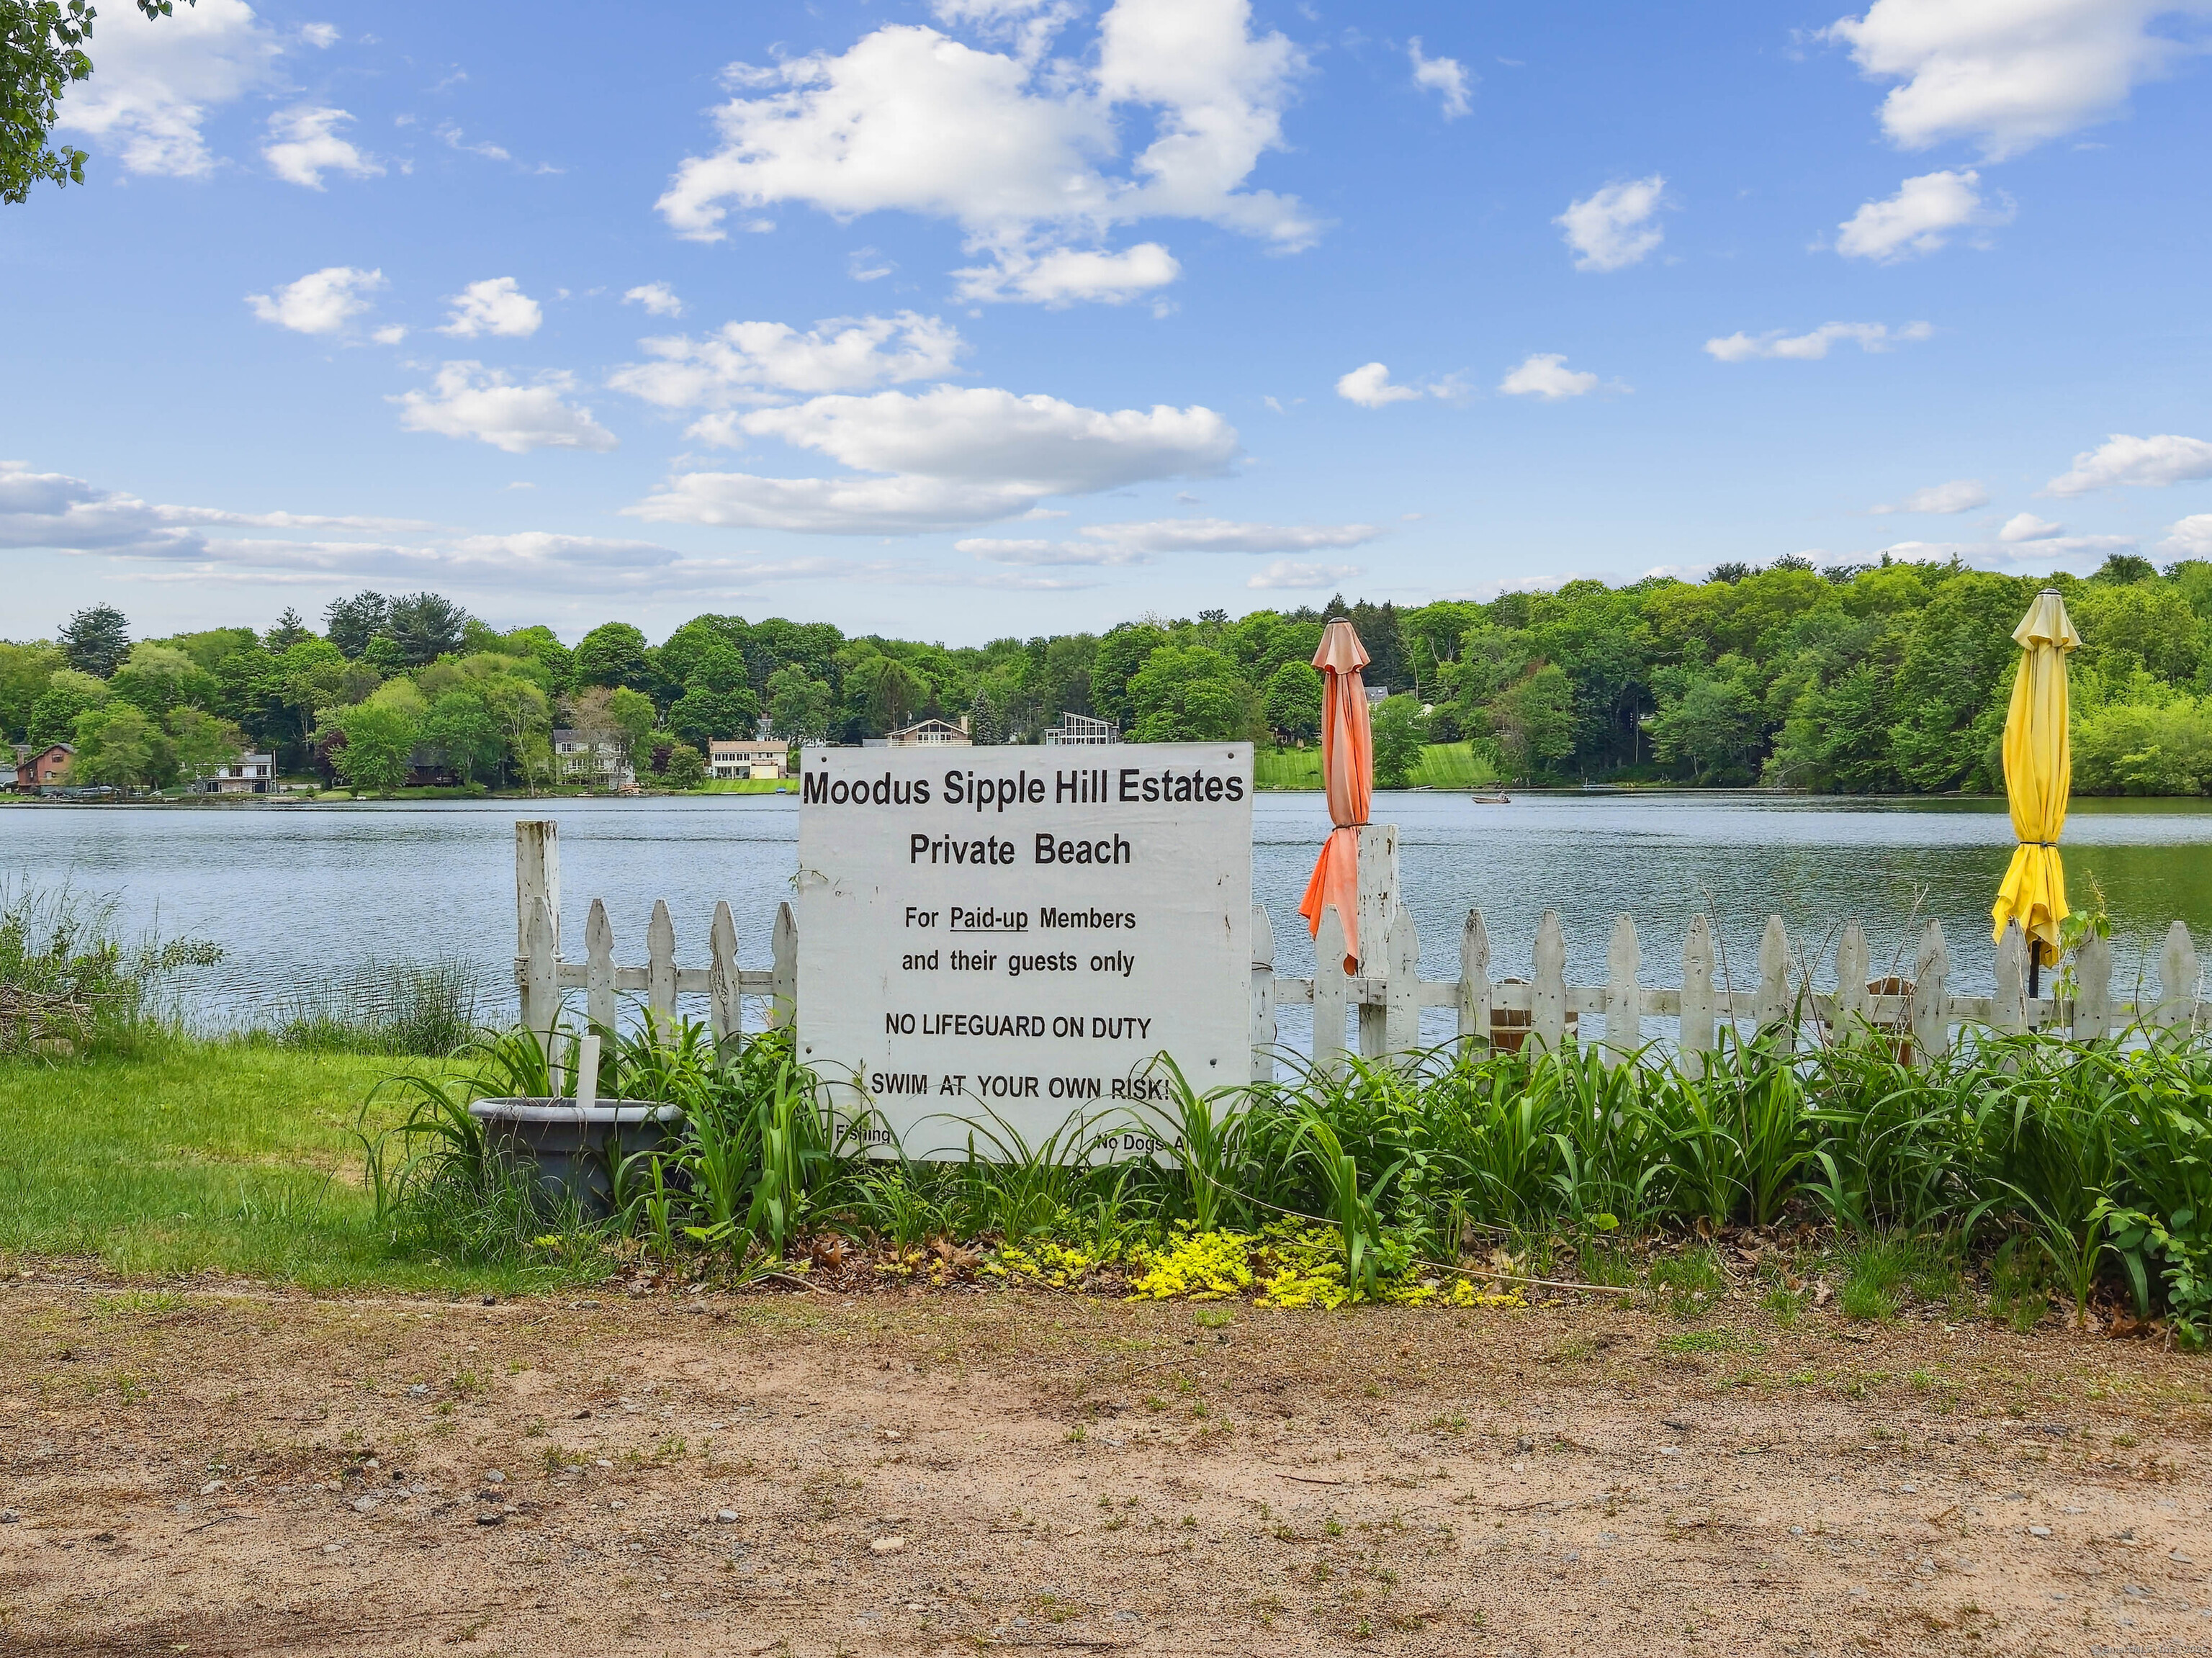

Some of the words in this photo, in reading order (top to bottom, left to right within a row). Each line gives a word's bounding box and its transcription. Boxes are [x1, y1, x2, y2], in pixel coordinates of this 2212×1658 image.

[804, 771, 930, 806] Moodus
[943, 770, 1046, 813] Sipple
[1056, 769, 1107, 804] Hill
[1119, 768, 1244, 803] Estates
[910, 834, 1015, 865] Private
[1035, 833, 1130, 865] Beach
[905, 906, 939, 928] For
[950, 906, 1029, 932] Paid-up
[1040, 907, 1136, 929] Members
[902, 949, 939, 970] and
[950, 950, 997, 970] their
[1008, 950, 1077, 977] guests
[1090, 950, 1135, 978] only
[886, 1012, 915, 1035] NO
[922, 1014, 1046, 1037] LIFEGUARD
[1053, 1016, 1084, 1038] ON
[1092, 1017, 1152, 1040] DUTY
[871, 1073, 927, 1094] SWIM
[939, 1074, 966, 1096] AT
[977, 1075, 1040, 1098] YOUR
[1048, 1077, 1101, 1099] OWN
[1112, 1078, 1169, 1100] RISK!
[1123, 1134, 1165, 1155] Dogs
